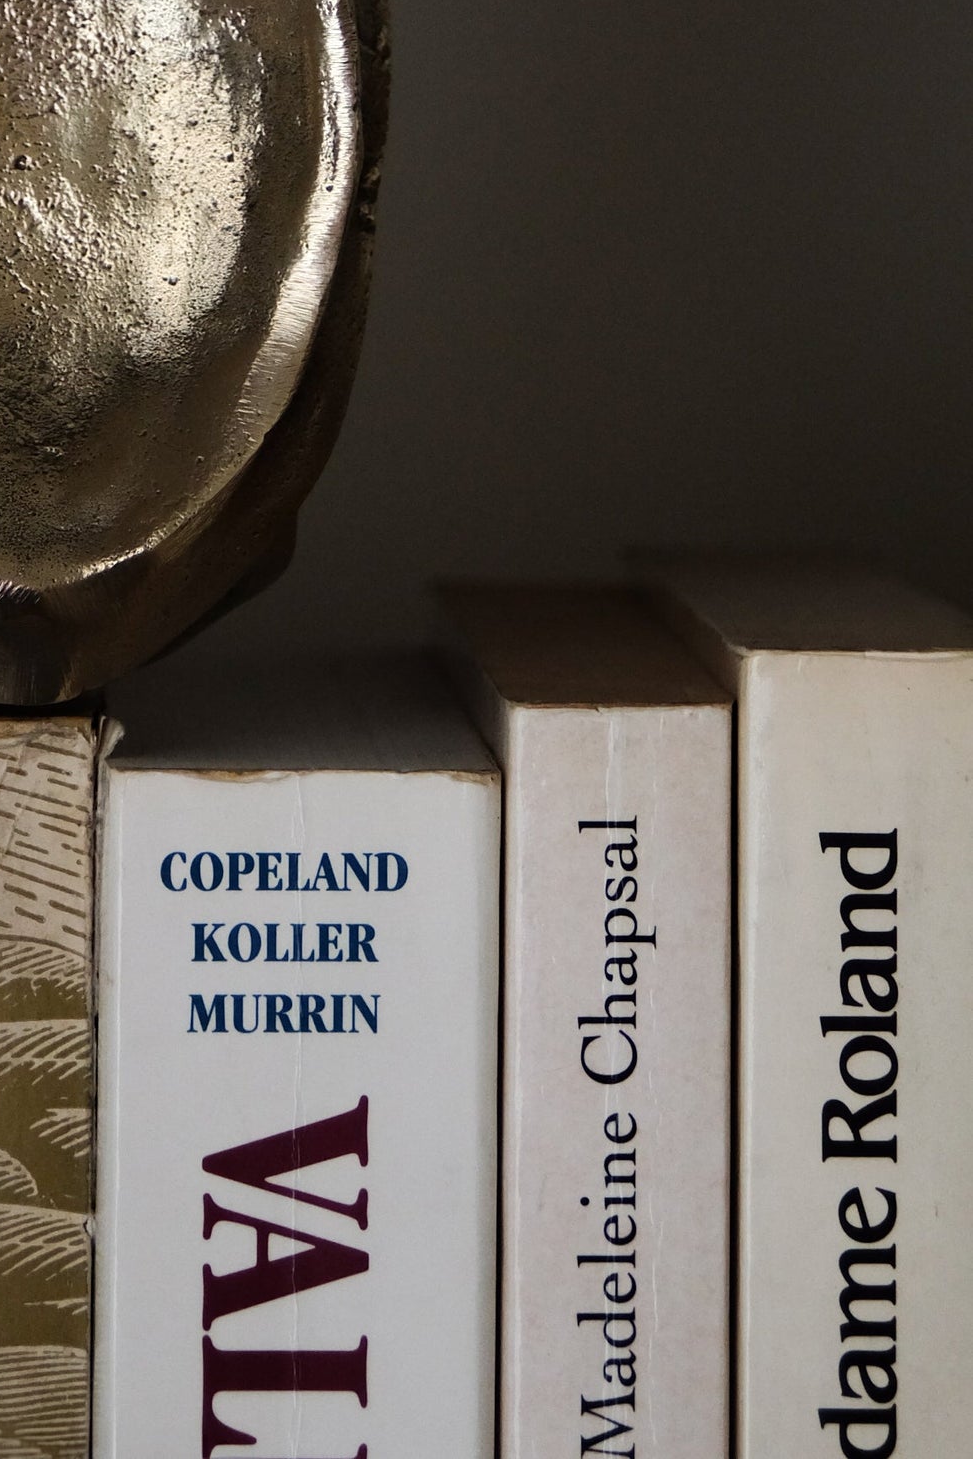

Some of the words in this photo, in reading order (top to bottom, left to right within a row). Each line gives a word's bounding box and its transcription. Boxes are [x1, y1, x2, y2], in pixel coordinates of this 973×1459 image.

[159, 851, 409, 893] COPELAND
[190, 922, 380, 963] KOLLER
[577, 814, 657, 1086] Chapsal
[818, 827, 899, 1164] Roland
[186, 993, 382, 1035] MURRIN
[201, 1094, 370, 1459] VAL
[576, 1111, 638, 1459] Madeleine
[817, 1185, 899, 1459] dame
